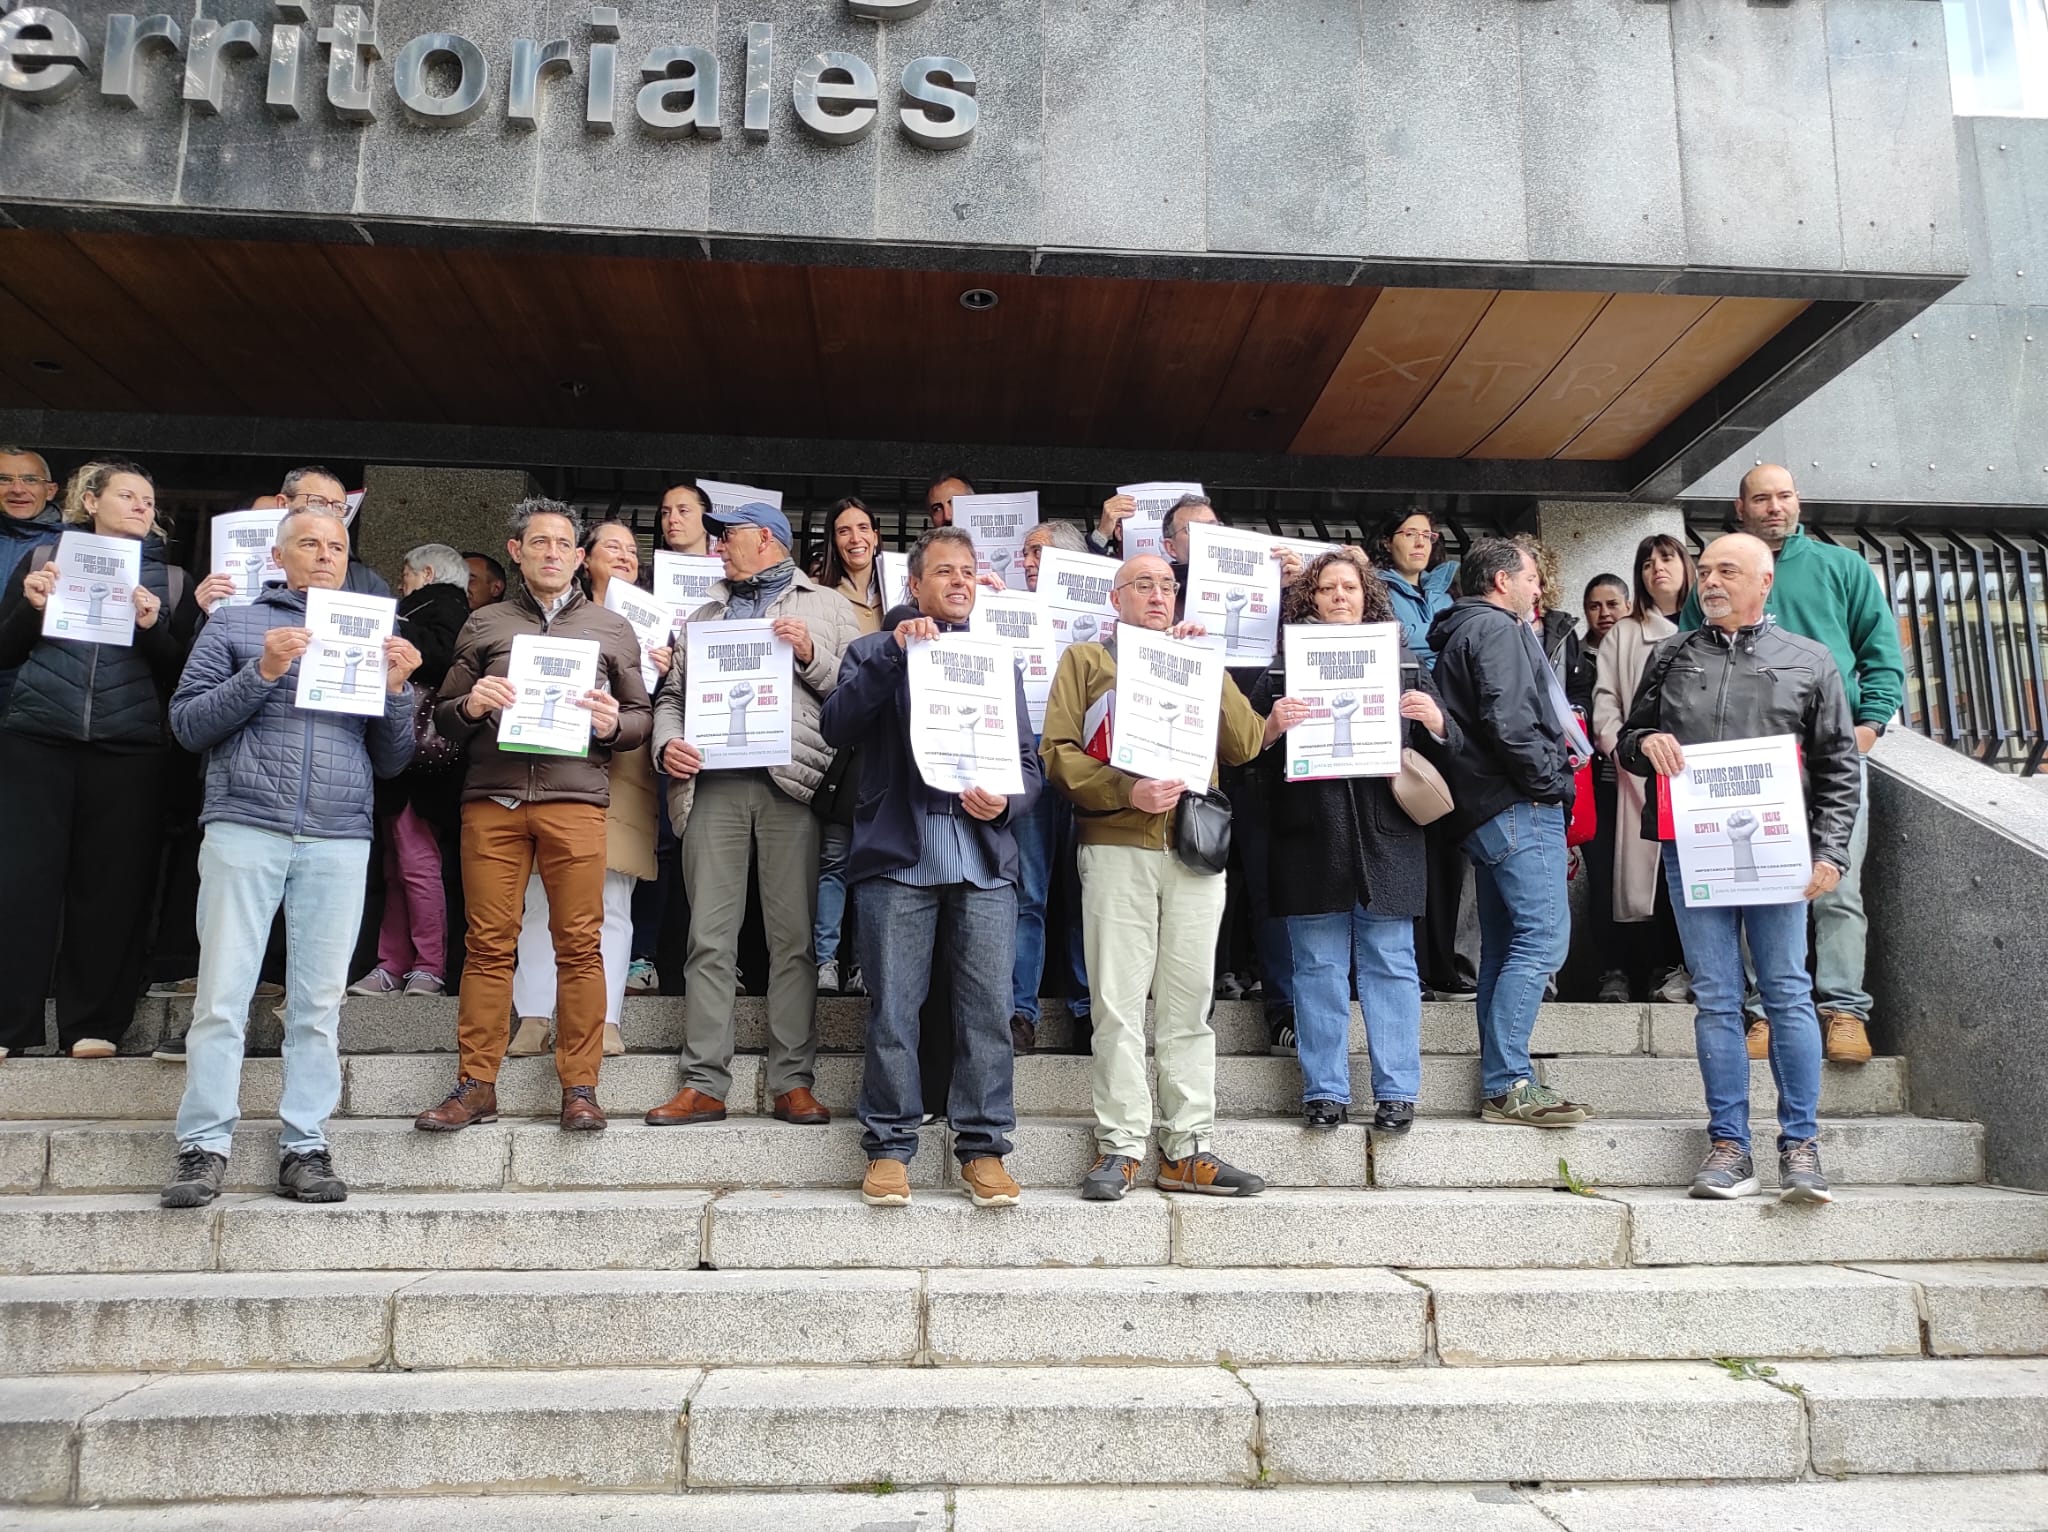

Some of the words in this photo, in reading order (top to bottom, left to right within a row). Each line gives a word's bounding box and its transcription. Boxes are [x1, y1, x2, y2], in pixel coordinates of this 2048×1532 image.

[1207, 545, 1233, 561] ESTAMOS
[1233, 549, 1244, 561] CON
[1244, 550, 1258, 564] TODO
[1217, 561, 1254, 576] PROFESORADO
[1057, 572, 1085, 588] ESTAMOS
[1085, 576, 1097, 590] CON
[1066, 587, 1107, 605] PROFESORADO
[708, 643, 736, 659] ESTAMOS
[736, 643, 750, 658] CON
[750, 642, 766, 656] TODO
[1307, 650, 1337, 666] ESTAMOS
[1337, 650, 1351, 666] CON
[1351, 650, 1369, 665] TODO
[719, 656, 761, 673] PROFESORADO
[931, 650, 960, 667] ESTAMOS
[960, 653, 972, 669] CON
[972, 655, 988, 672] TODO
[1139, 646, 1166, 664] ESTAMOS
[1167, 653, 1179, 669] CON
[1179, 656, 1195, 675] TODO
[944, 666, 985, 686] PROFESORADO
[1150, 662, 1189, 687] PROFESORADO
[1319, 664, 1365, 680] PROFESORADO
[702, 693, 719, 704] RESPETO
[1693, 767, 1727, 784] ESTAMOS
[1728, 766, 1743, 780] CON
[1744, 763, 1764, 780] TODO
[1764, 762, 1773, 778] EL
[1709, 780, 1761, 798] PROFESORADO
[1694, 822, 1716, 834] RESPETO
[1763, 824, 1789, 836] DOCENTES
